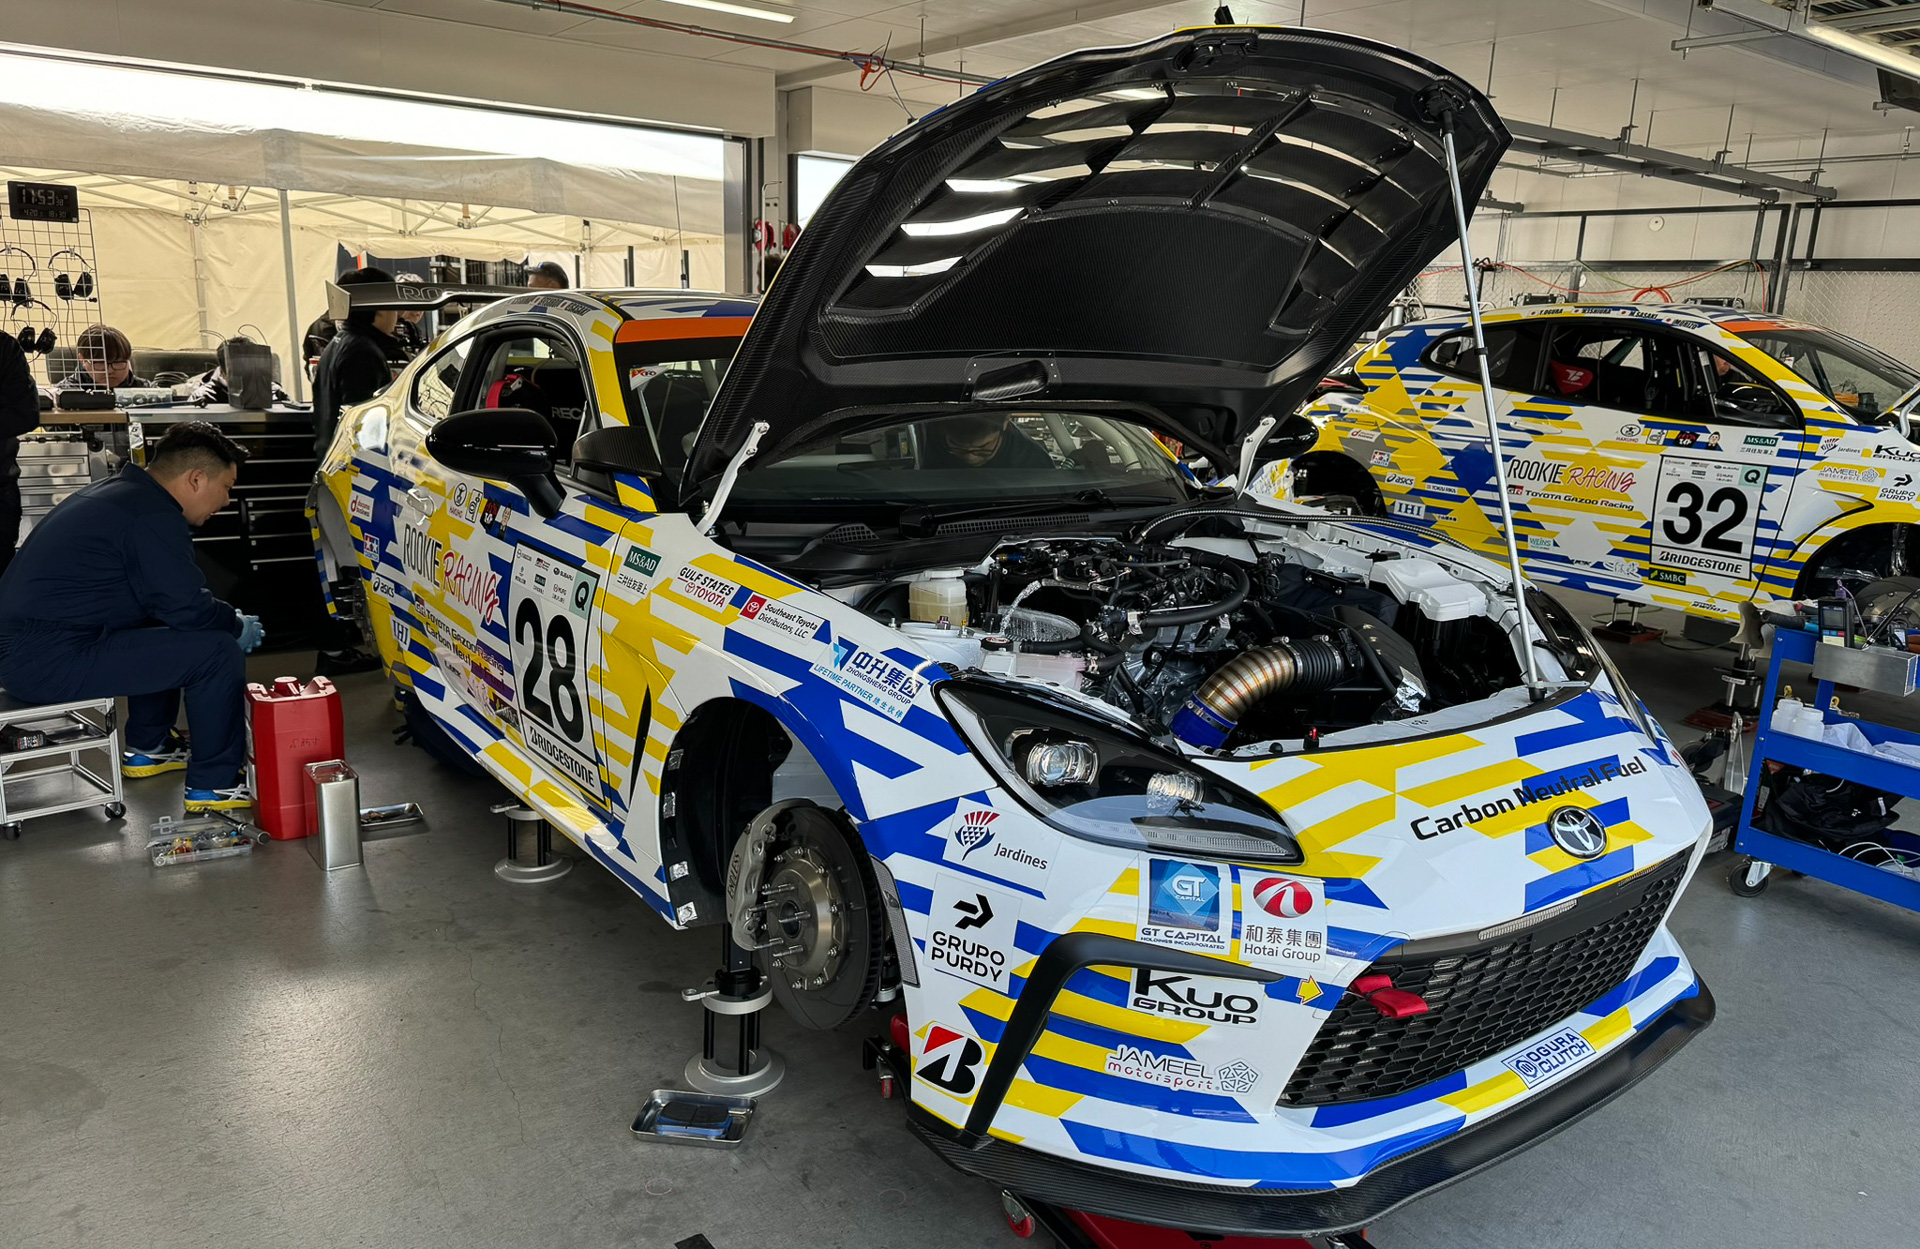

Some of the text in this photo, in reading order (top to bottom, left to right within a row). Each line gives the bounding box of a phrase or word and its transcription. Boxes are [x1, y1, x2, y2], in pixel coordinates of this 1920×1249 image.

[1746, 436, 1776, 445] MS&AD
[1394, 476, 1414, 486] asics
[1507, 459, 1637, 493] ROOKIE RACING
[1744, 469, 1761, 484] Q
[1820, 466, 1859, 477] JAMEEL
[1525, 489, 1562, 501] TOYOTA
[1600, 499, 1635, 512] Racing
[1879, 493, 1915, 502] PURDY
[1881, 488, 1916, 498] GRUPO
[1399, 501, 1422, 516] IHI
[1662, 481, 1748, 555] 32
[403, 523, 500, 623] ROOKIE RACING
[628, 551, 657, 571] MS&AD
[1659, 550, 1743, 574] BRIDGESTONE
[380, 582, 395, 598] asics
[679, 566, 735, 597] GULF STATES
[1659, 571, 1685, 584] SMBC
[574, 581, 590, 612] Q
[692, 584, 726, 609] TOYOTA
[757, 612, 809, 640] Distributors, LLC
[764, 603, 818, 631] Southeast Toyota
[391, 619, 410, 646] IHI
[425, 621, 452, 651] Carbon
[426, 608, 452, 636] TOYOTA
[476, 645, 505, 676] Racing
[515, 598, 584, 743] 28
[813, 664, 842, 684] LIFETIME
[841, 679, 873, 702] PARTNER
[846, 666, 912, 706] ZHONGSHENG GROUP
[529, 726, 595, 788] BRIDGESTONE
[1410, 756, 1648, 841] Carbon Neutral Fuel
[994, 843, 1048, 869] Jardines
[1172, 875, 1207, 897] GT
[932, 930, 1005, 966] GRUPO
[1140, 936, 1225, 951] HOLDINGS INCORPORATED
[1141, 928, 1225, 944] GT CAPITAL
[1245, 924, 1322, 949] 和泰集團
[931, 946, 1003, 982] PURDY
[1244, 943, 1321, 963] Hotai Group
[1135, 967, 1258, 1014] KUO
[1132, 997, 1257, 1025] GROUP
[1526, 1032, 1580, 1062] OGURA
[1537, 1040, 1591, 1073] CLUTCH
[1107, 1061, 1213, 1091] motorsport
[1109, 1047, 1213, 1079] JAMEEL
